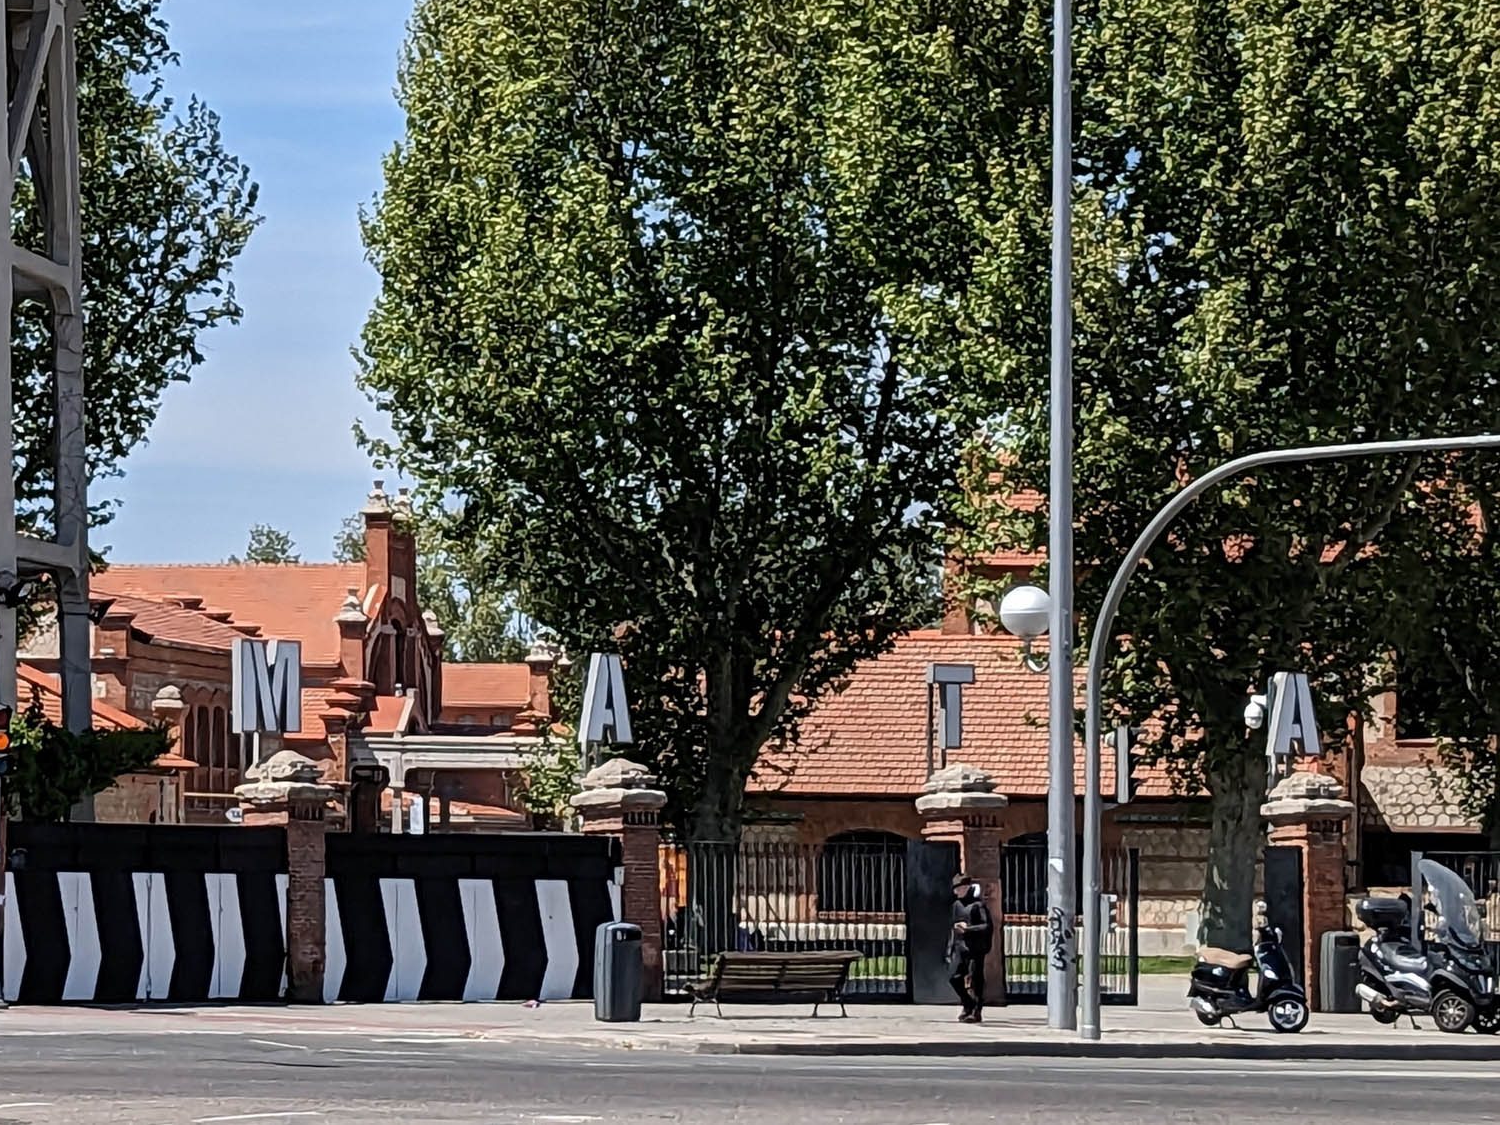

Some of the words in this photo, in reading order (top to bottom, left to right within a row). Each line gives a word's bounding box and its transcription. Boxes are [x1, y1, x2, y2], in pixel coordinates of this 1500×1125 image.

[231, 639, 302, 733] M
[578, 652, 633, 744] A
[926, 663, 975, 749] T
[1265, 671, 1322, 756] A
